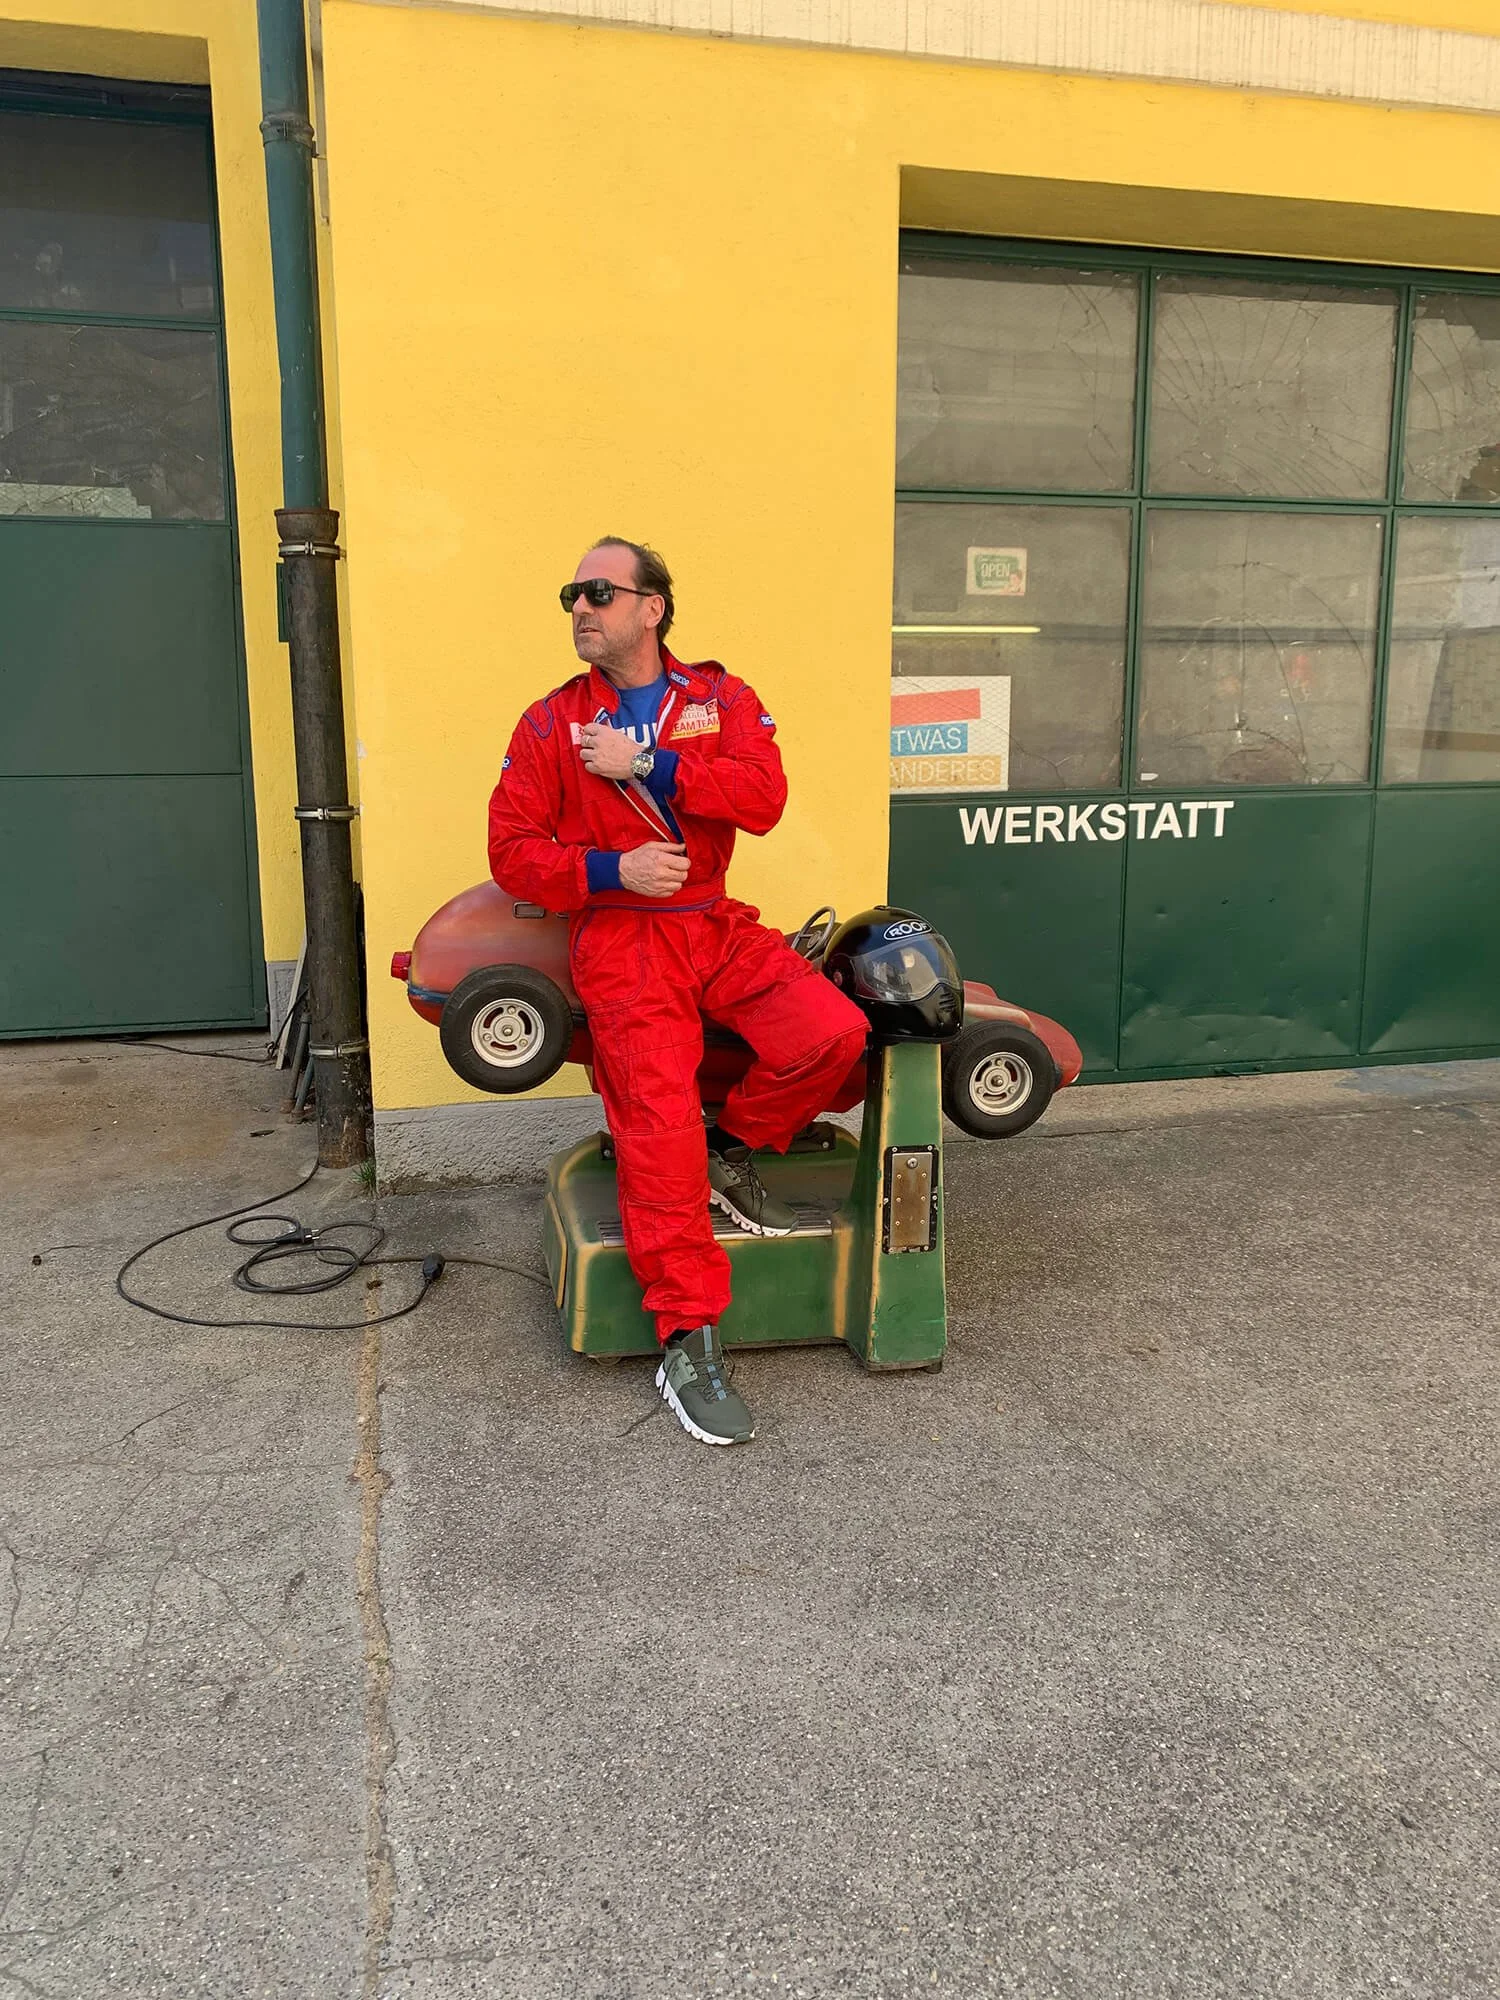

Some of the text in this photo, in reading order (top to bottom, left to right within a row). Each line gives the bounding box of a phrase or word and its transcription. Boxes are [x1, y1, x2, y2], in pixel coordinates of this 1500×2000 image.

[980, 562, 1011, 578] OPEN
[672, 721, 696, 733] EAM
[892, 727, 962, 752] TWAS
[890, 759, 996, 784] ANDERES
[959, 800, 1235, 845] WERKSTATT
[889, 921, 929, 937] ROOF
